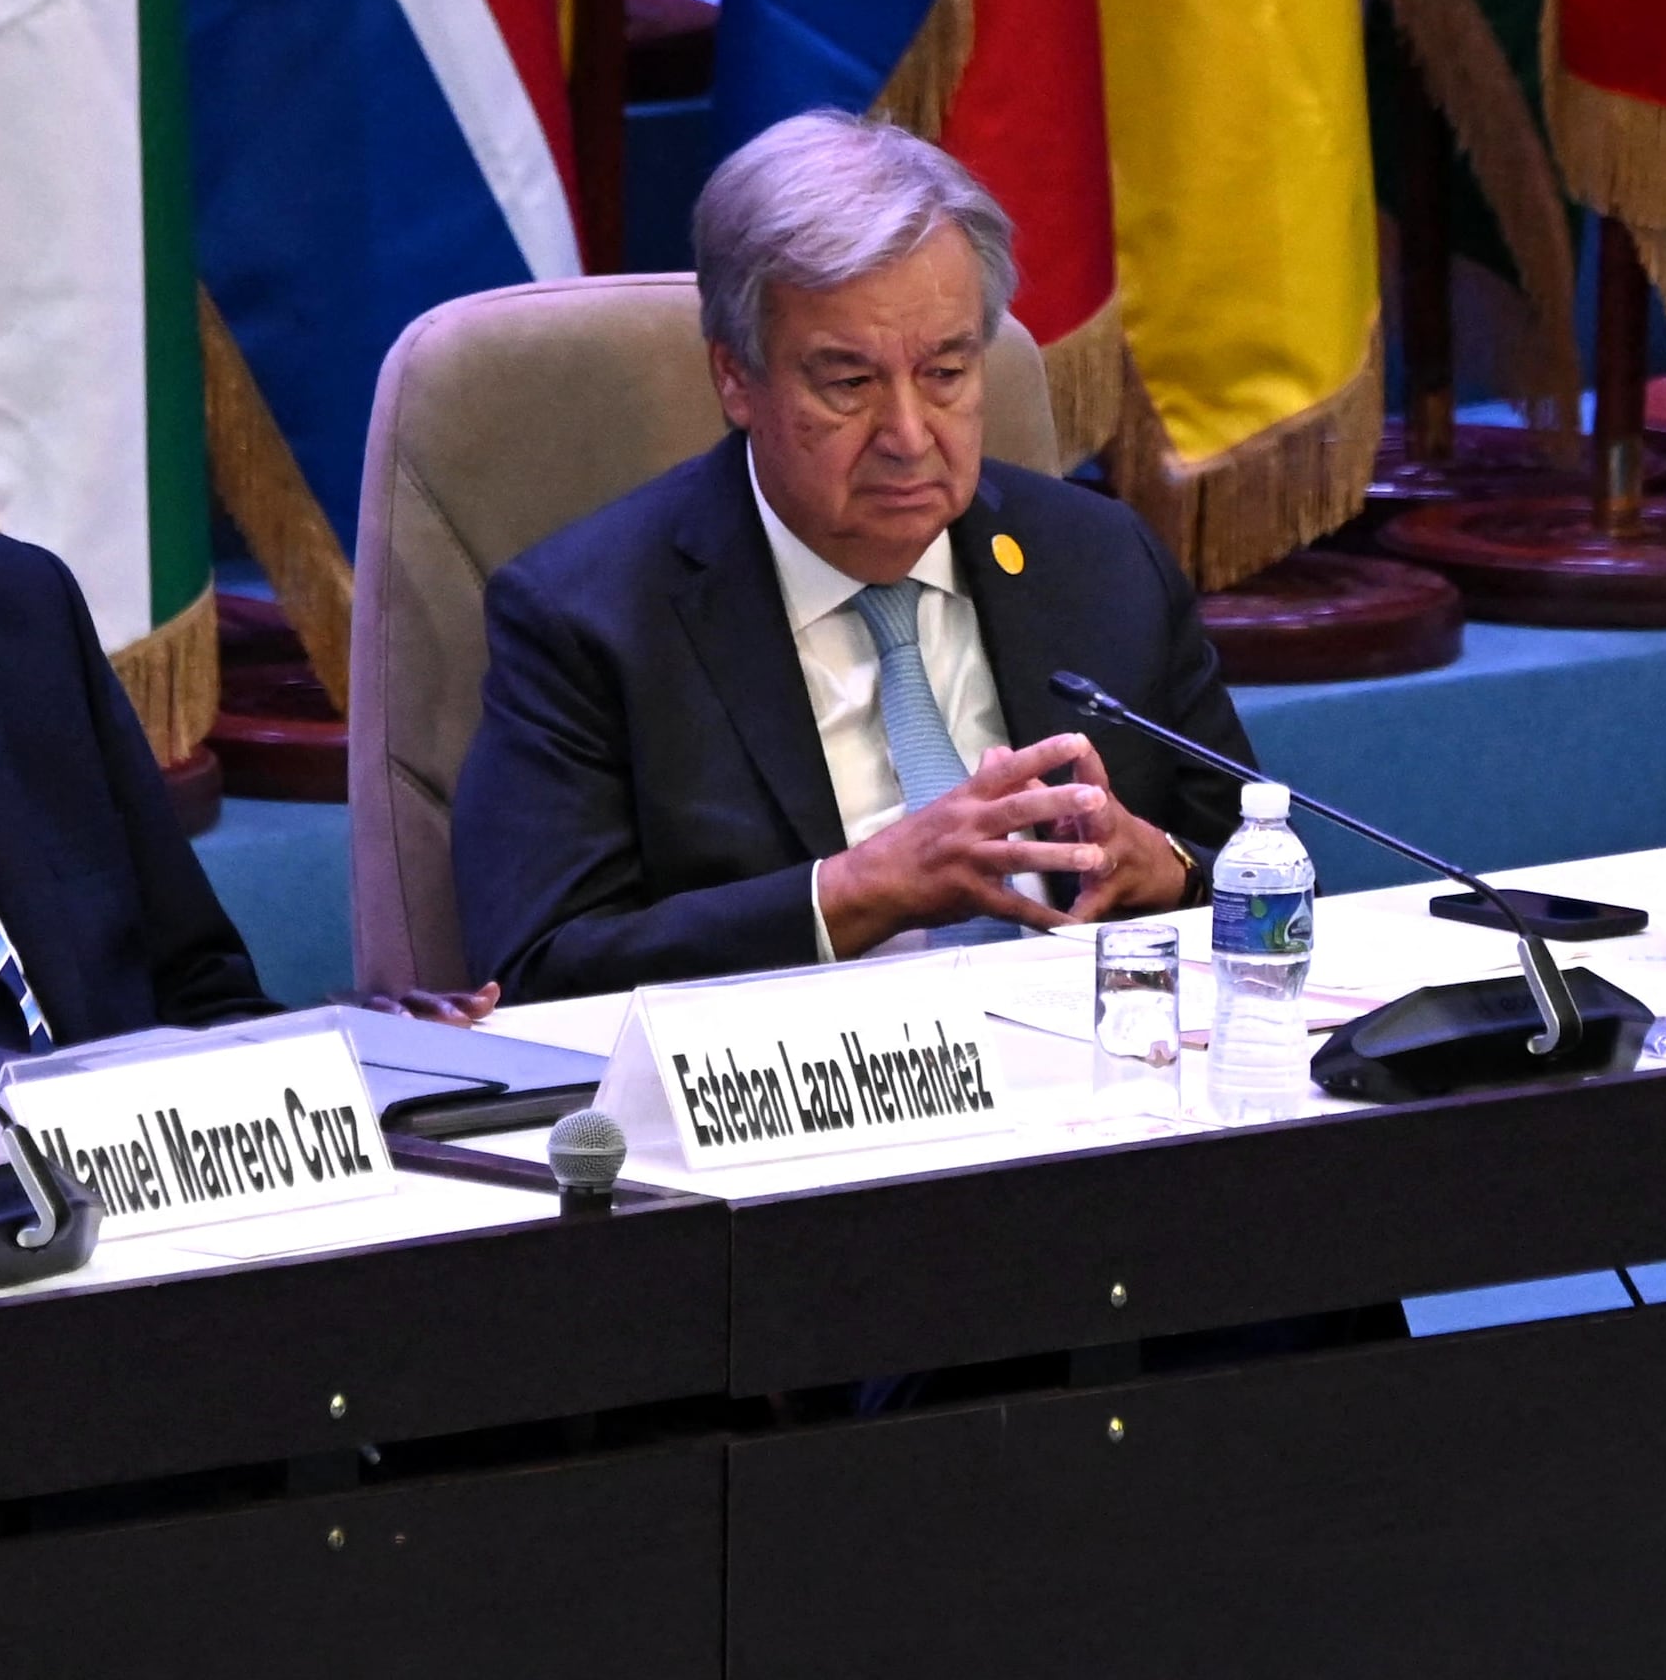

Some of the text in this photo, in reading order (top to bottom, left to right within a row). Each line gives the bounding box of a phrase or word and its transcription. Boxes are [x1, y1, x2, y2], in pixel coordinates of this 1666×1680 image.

[672, 1020, 994, 1147] Esteban Lazo Hernández
[154, 1108, 294, 1204] Marrero
[284, 1087, 373, 1182] Cruz
